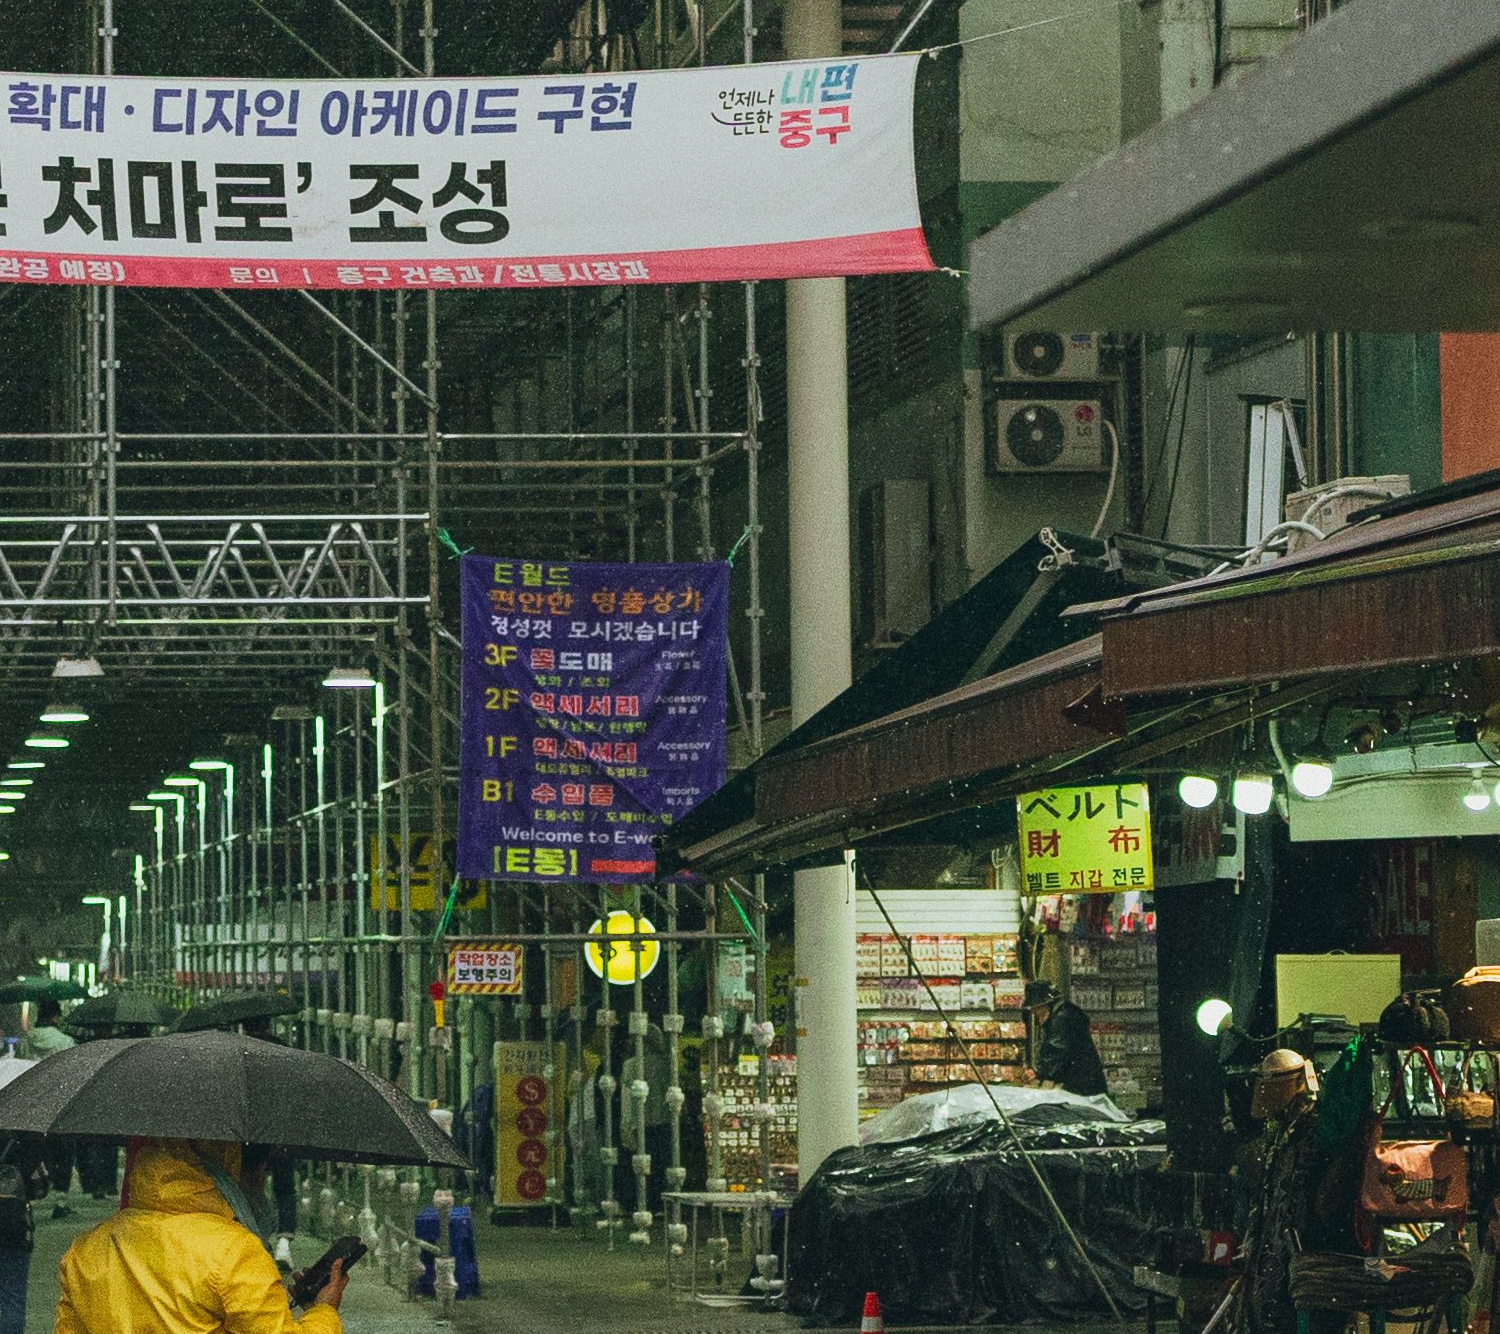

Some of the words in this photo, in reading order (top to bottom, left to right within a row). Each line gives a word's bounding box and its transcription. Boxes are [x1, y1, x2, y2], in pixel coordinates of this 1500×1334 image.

[779, 62, 860, 105] 내편
[7, 81, 106, 133] 확대
[152, 87, 300, 137] 디자인
[320, 87, 520, 138] 아케이드
[536, 81, 638, 135] 구현
[718, 88, 776, 110] 언제나
[777, 105, 852, 149] 중구
[349, 159, 511, 245] 조성
[58, 259, 126, 282] 예정)
[229, 266, 279, 284] 문의
[511, 259, 649, 283] 전통시장과
[491, 615, 552, 640] 정성껏
[568, 618, 703, 642] 모시겠습니다
[483, 642, 519, 667] 3F
[484, 687, 520, 711] 2F
[530, 692, 640, 717] 액세서리
[655, 694, 709, 705] Accessory
[484, 734, 519, 759] 1F
[532, 737, 638, 764] 액세서리
[656, 740, 712, 751] Accessory
[482, 779, 514, 803] B1
[531, 782, 614, 806] 수입품
[1024, 784, 1139, 822] ベルト
[501, 826, 584, 843] Welcome
[588, 828, 610, 844] to
[1026, 871, 1061, 892] 벨트
[1069, 869, 1103, 890] 지갑
[1112, 867, 1146, 887] 전문
[457, 967, 512, 982] 보행주의
